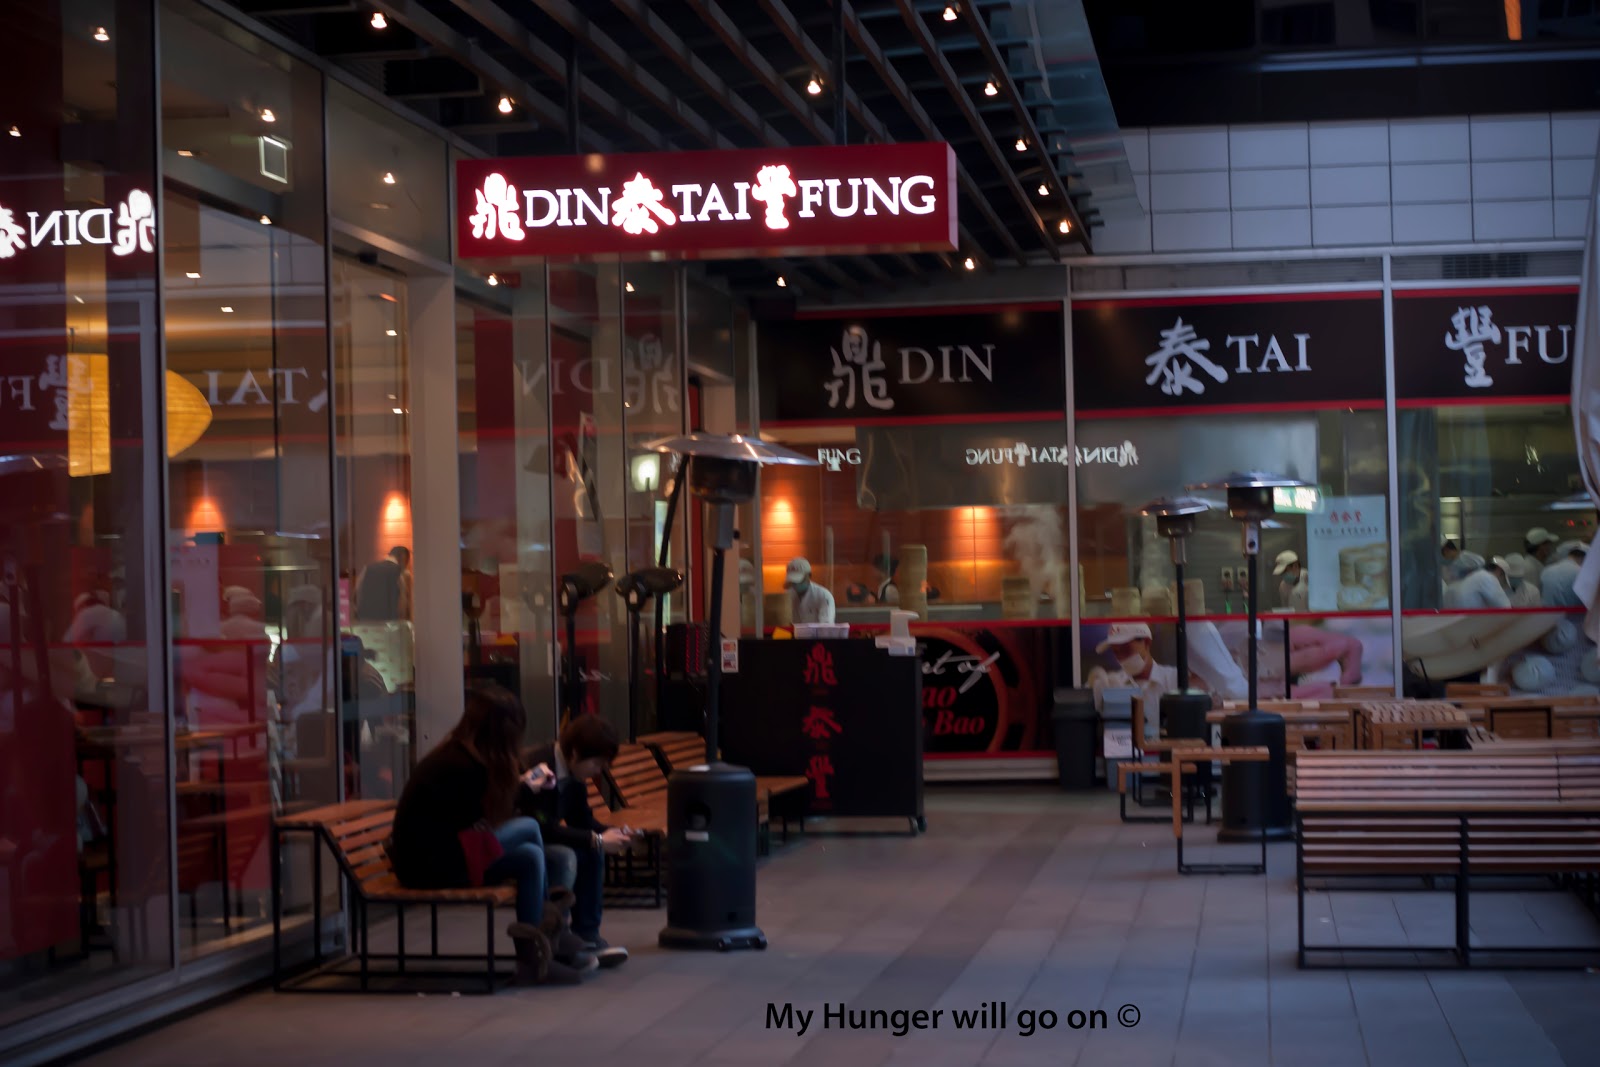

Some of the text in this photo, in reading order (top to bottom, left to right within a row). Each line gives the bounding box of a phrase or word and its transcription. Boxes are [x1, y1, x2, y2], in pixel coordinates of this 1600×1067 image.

[523, 187, 612, 228] DIN
[611, 171, 677, 235] 泰
[672, 183, 752, 222] TAI
[798, 175, 937, 219] FUNG
[824, 325, 996, 410] 鼎 DIN
[1144, 317, 1312, 397] 泰 TAI
[1504, 324, 1575, 365] FU
[933, 709, 985, 735] Bao
